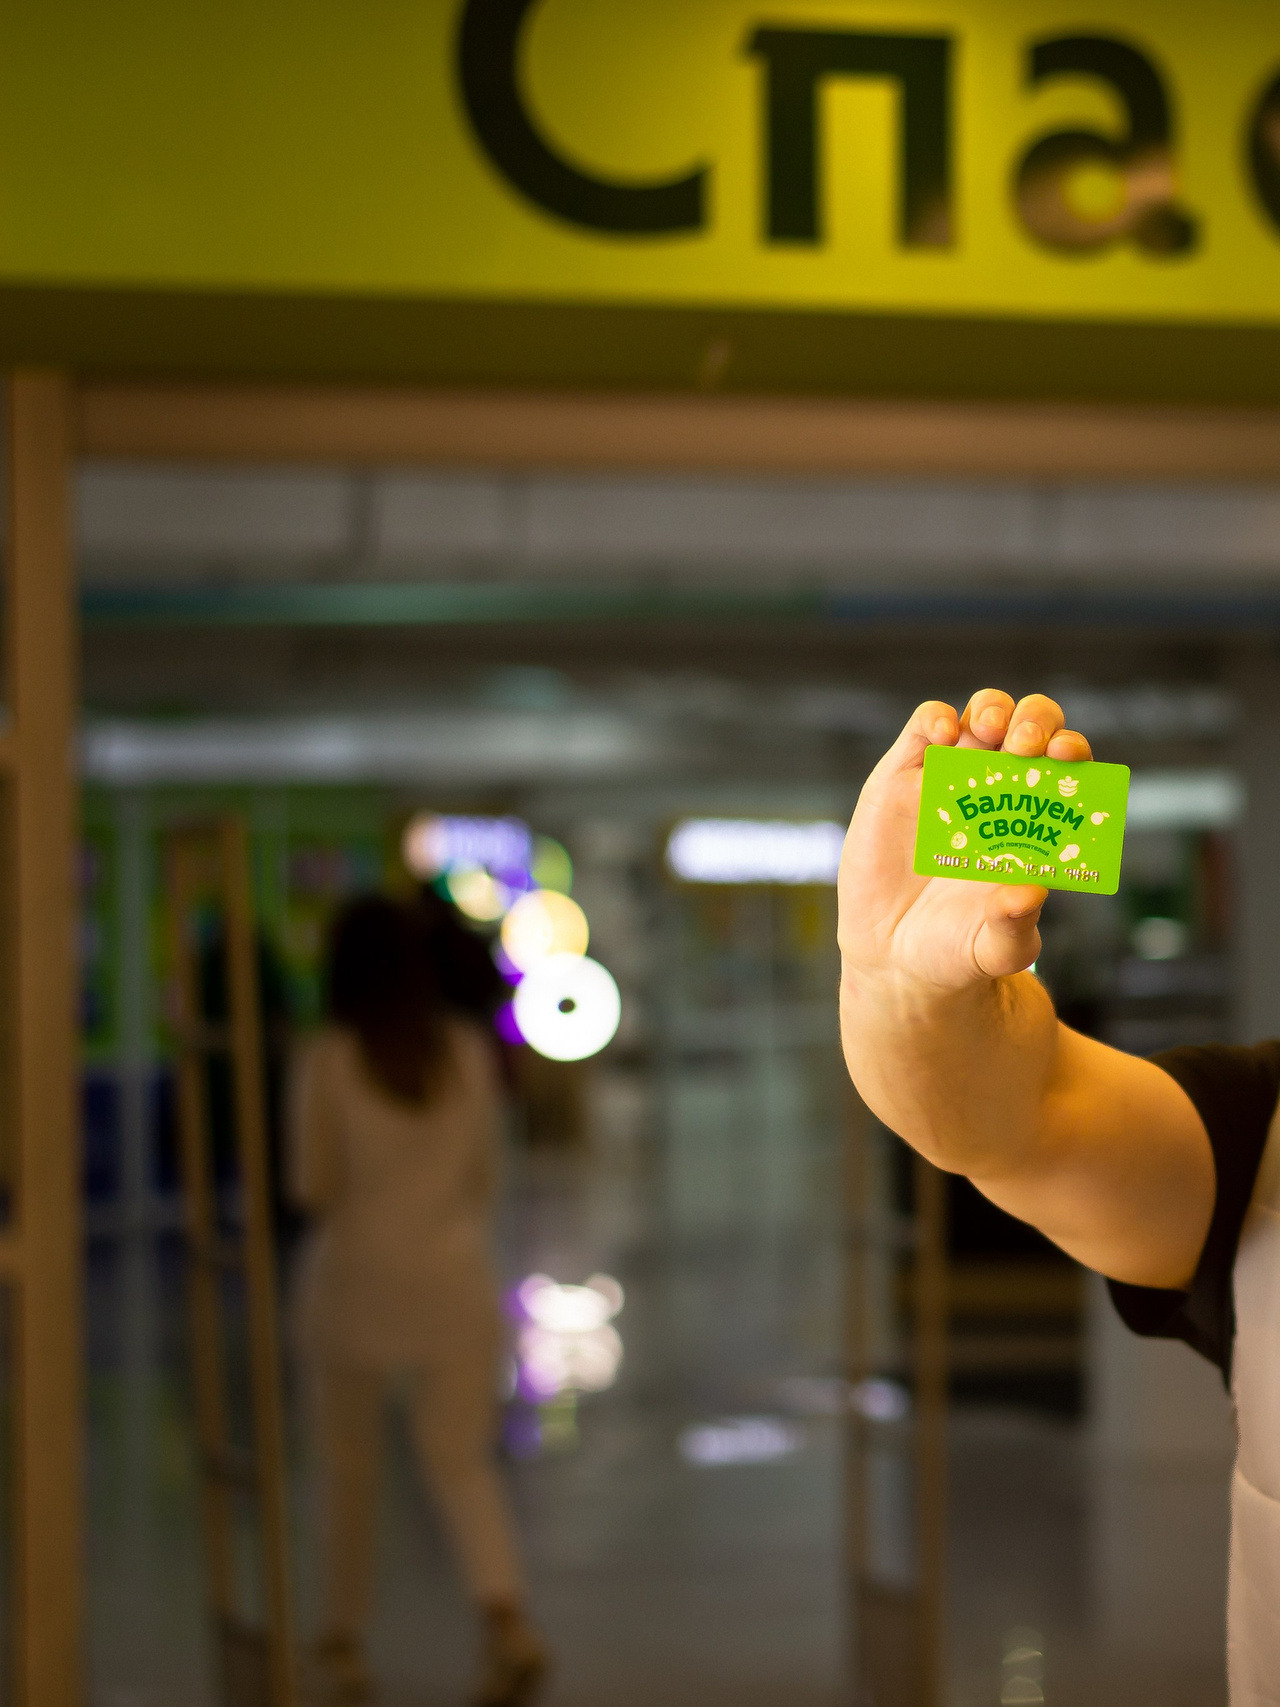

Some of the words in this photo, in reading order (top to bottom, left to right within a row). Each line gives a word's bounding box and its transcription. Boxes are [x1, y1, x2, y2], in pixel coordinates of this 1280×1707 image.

[956, 793, 1085, 831] Баллуем
[978, 818, 1062, 847] своих
[988, 841, 1004, 851] клуб
[1006, 842, 1050, 857] покупателей
[934, 854, 969, 868] 9003
